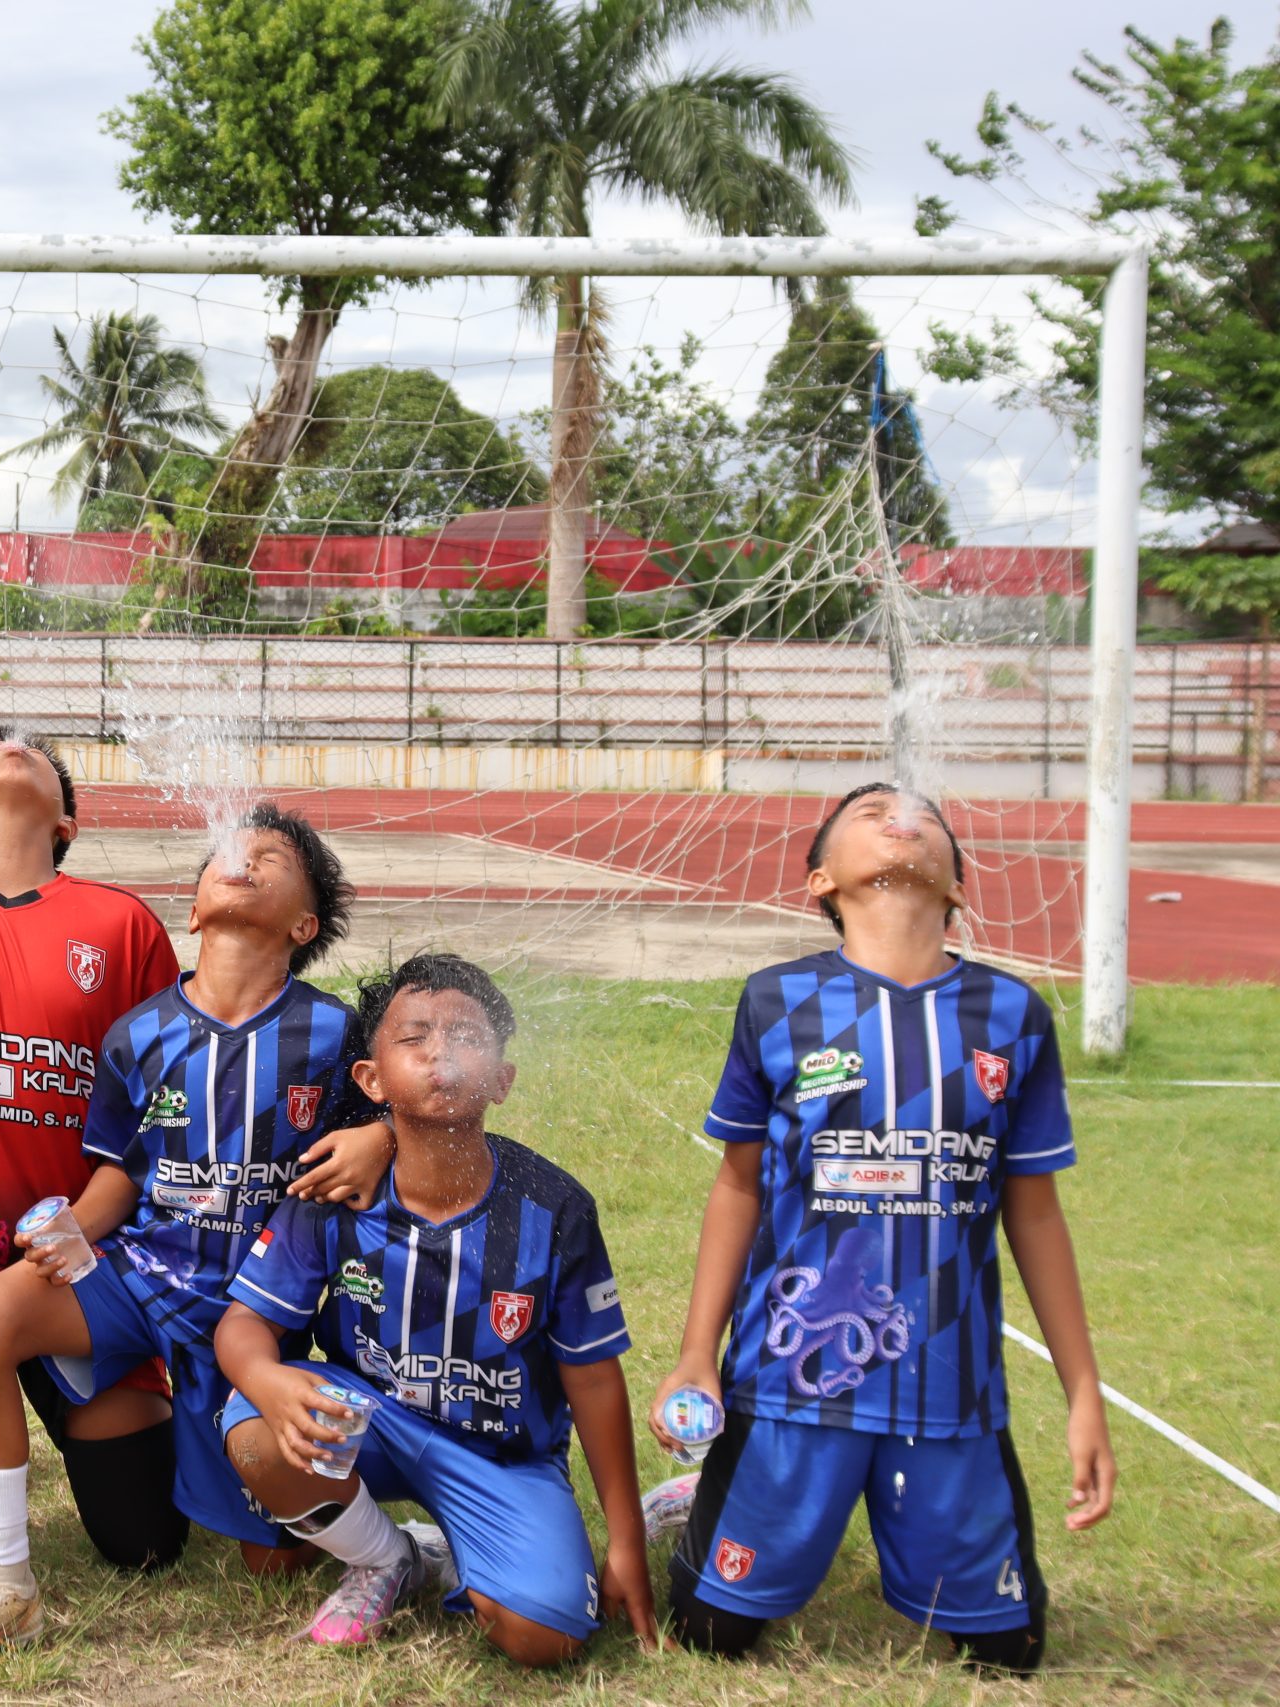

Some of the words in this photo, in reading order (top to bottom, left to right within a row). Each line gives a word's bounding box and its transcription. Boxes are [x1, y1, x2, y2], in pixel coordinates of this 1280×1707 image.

[806, 1056, 836, 1070] MILO
[22, 1069, 93, 1100] KAUR
[43, 1112, 60, 1127] S.
[852, 1169, 889, 1180] ADIB
[811, 1198, 874, 1215] ABDUL
[880, 1201, 948, 1219] HAMID,
[188, 1215, 248, 1237] HAMID,
[345, 1264, 369, 1279] MILO
[440, 1382, 522, 1409] KAUR
[462, 1420, 478, 1432] S.
[483, 1419, 510, 1433] Pd.
[998, 1559, 1023, 1602] 4
